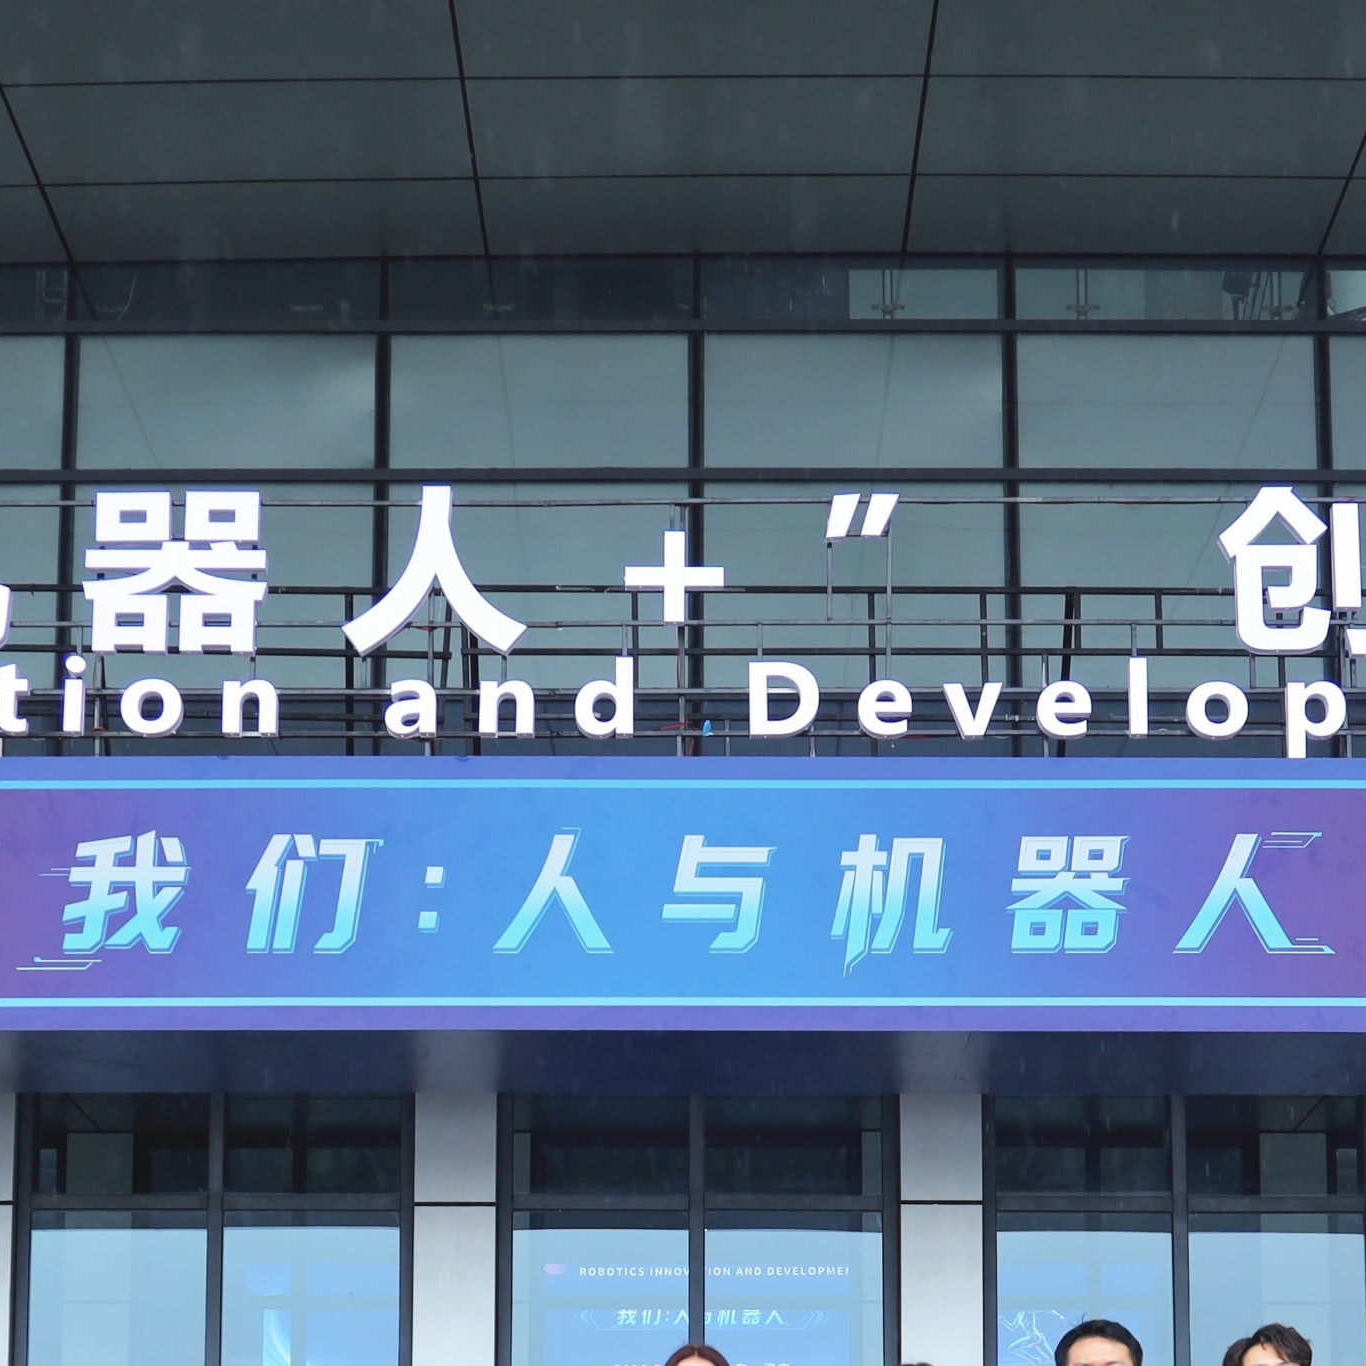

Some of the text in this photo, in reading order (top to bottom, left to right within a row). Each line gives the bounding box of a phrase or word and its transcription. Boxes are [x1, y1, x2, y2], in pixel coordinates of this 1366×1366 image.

[383, 656, 636, 740] and
[579, 1266, 646, 1278] ROBOTICS
[650, 1266, 732, 1278] INNOVION
[735, 1266, 763, 1277] AND
